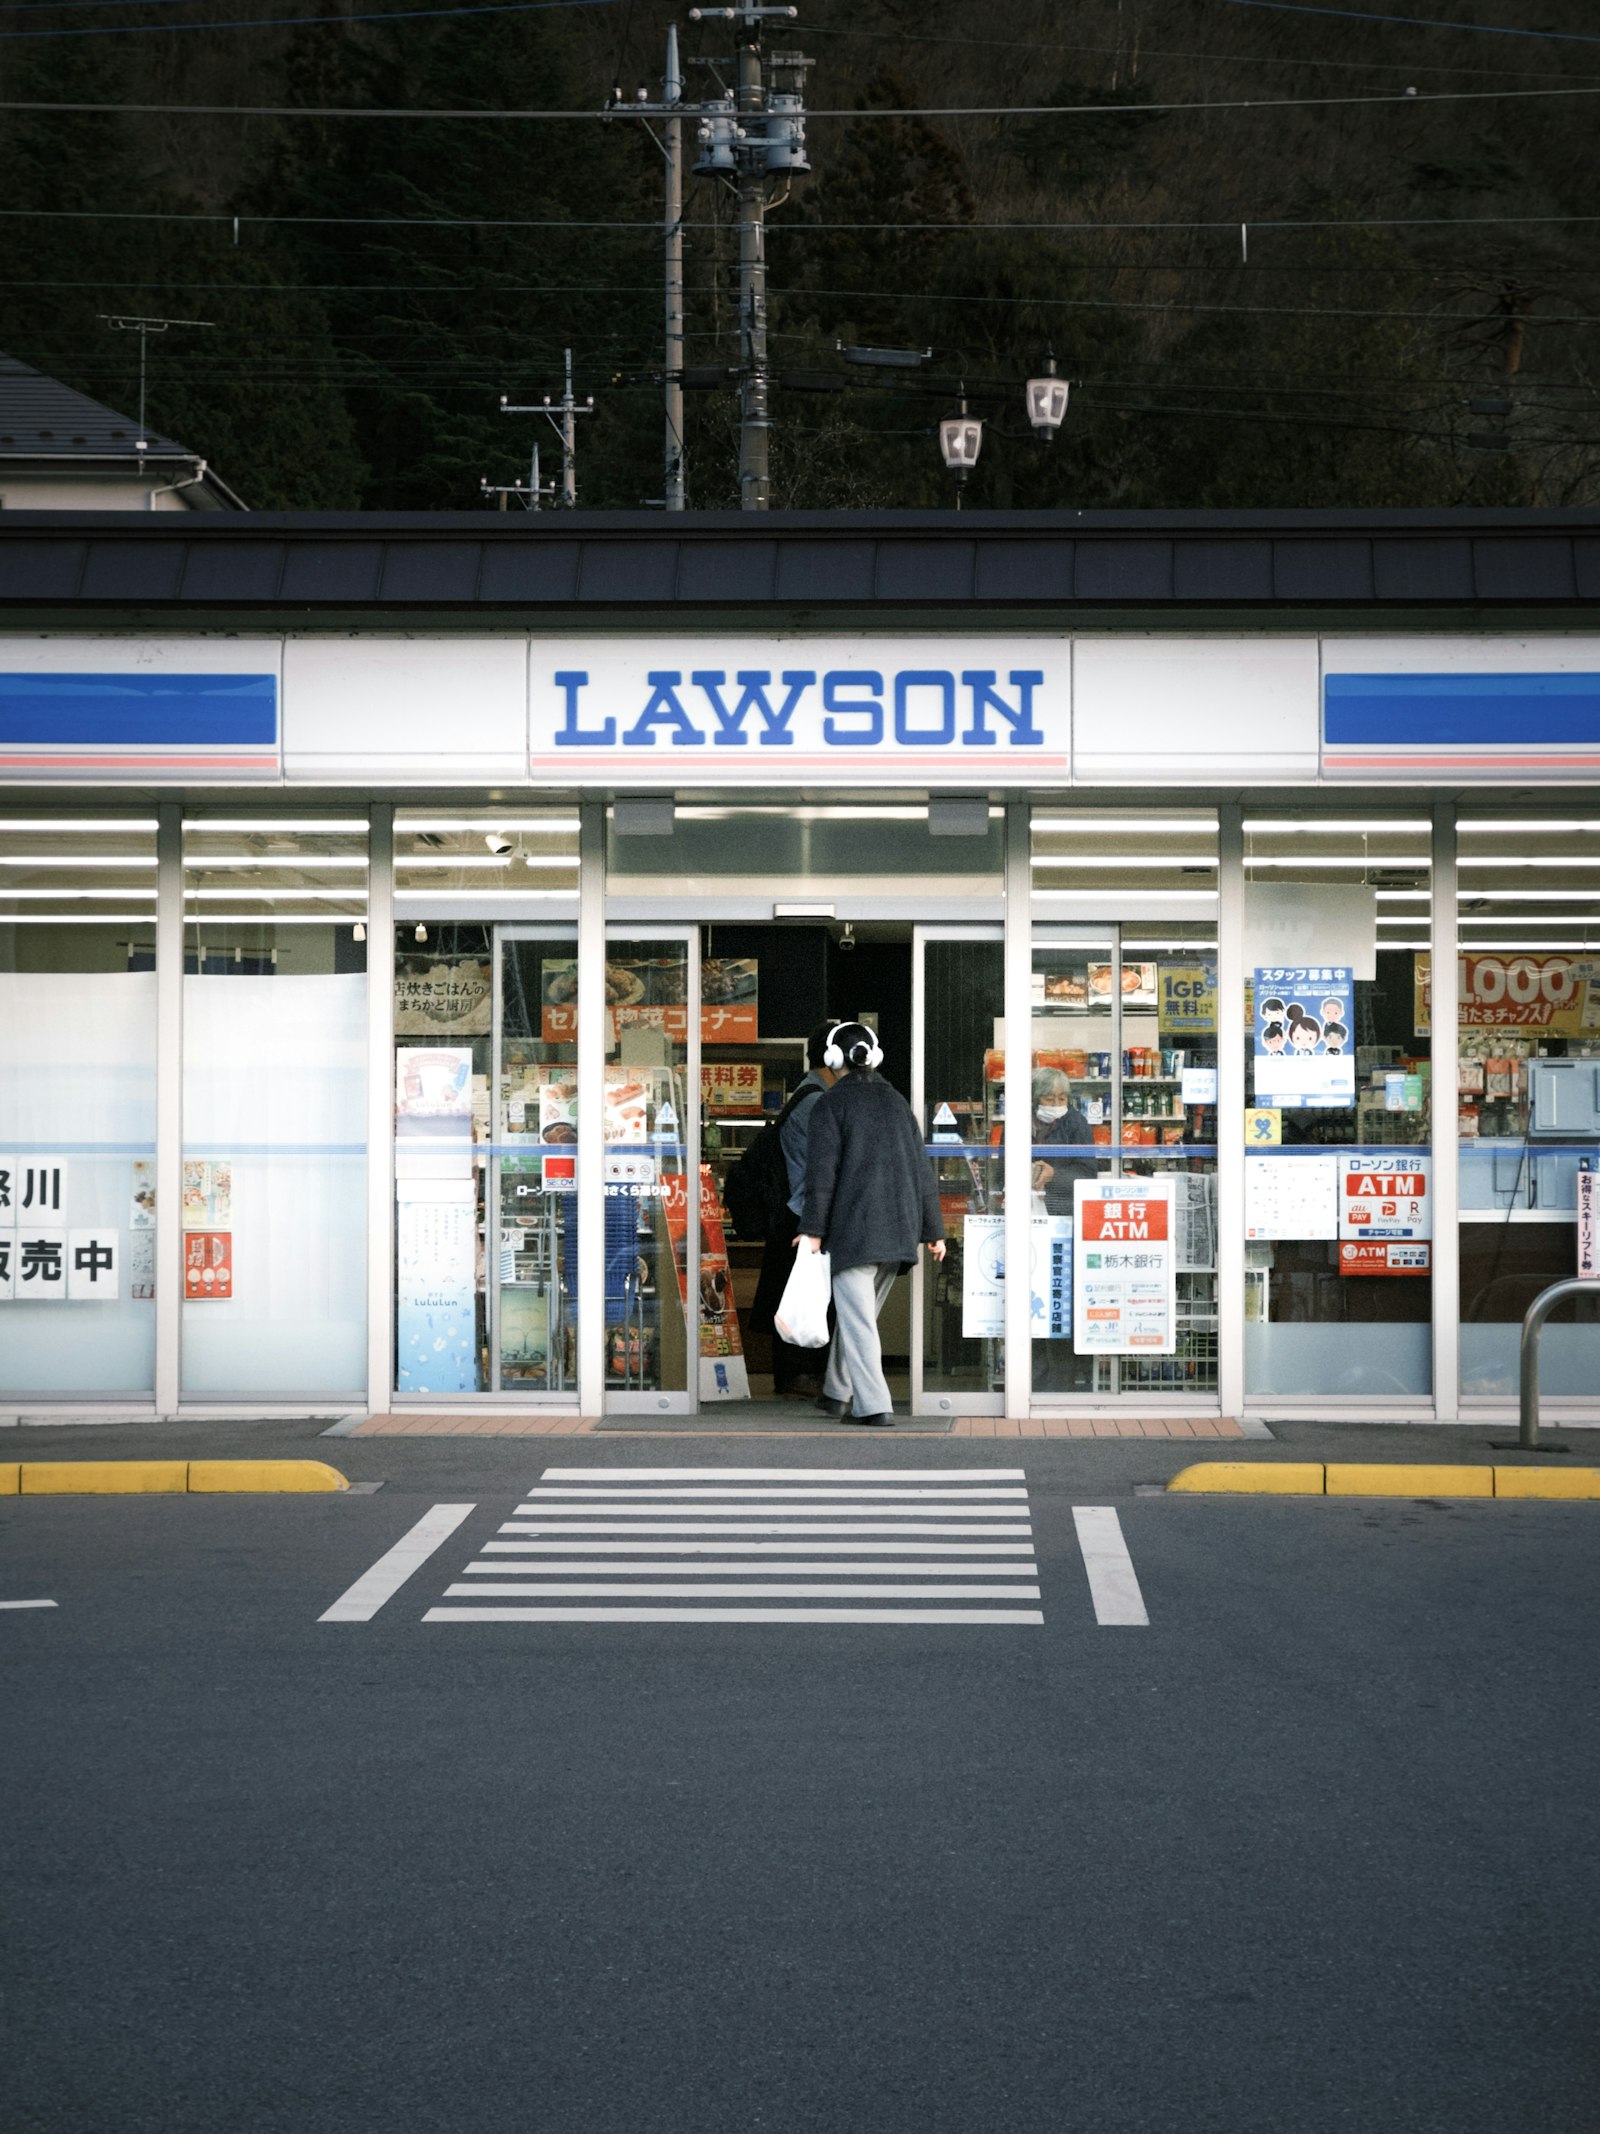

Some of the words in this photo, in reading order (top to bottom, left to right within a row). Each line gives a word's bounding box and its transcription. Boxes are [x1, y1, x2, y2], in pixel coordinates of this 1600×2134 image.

[554, 670, 1044, 745] LAWSON
[1262, 969, 1346, 981] スタッフ募集中
[1164, 975, 1205, 998] 1GB
[1165, 999, 1199, 1016] 無料
[1350, 1159, 1422, 1171] ローソン銀行
[0, 1168, 60, 1210] 川
[546, 1178, 574, 1187] SECOM
[1357, 1175, 1415, 1195] ATM
[1103, 1202, 1147, 1220] 銀行
[1352, 1213, 1368, 1221] PAY
[1377, 1217, 1401, 1225] PayPay
[1407, 1216, 1423, 1225] Pay
[1580, 1175, 1592, 1271] お得なスキーリフト券
[1099, 1221, 1149, 1239] ATM
[0, 1239, 114, 1282] 売中
[1358, 1247, 1386, 1257] ATM
[1104, 1254, 1164, 1269] 栃木銀行
[1051, 1243, 1063, 1334] 警察官立寄り店舗
[414, 1298, 458, 1306] LuLuLun
